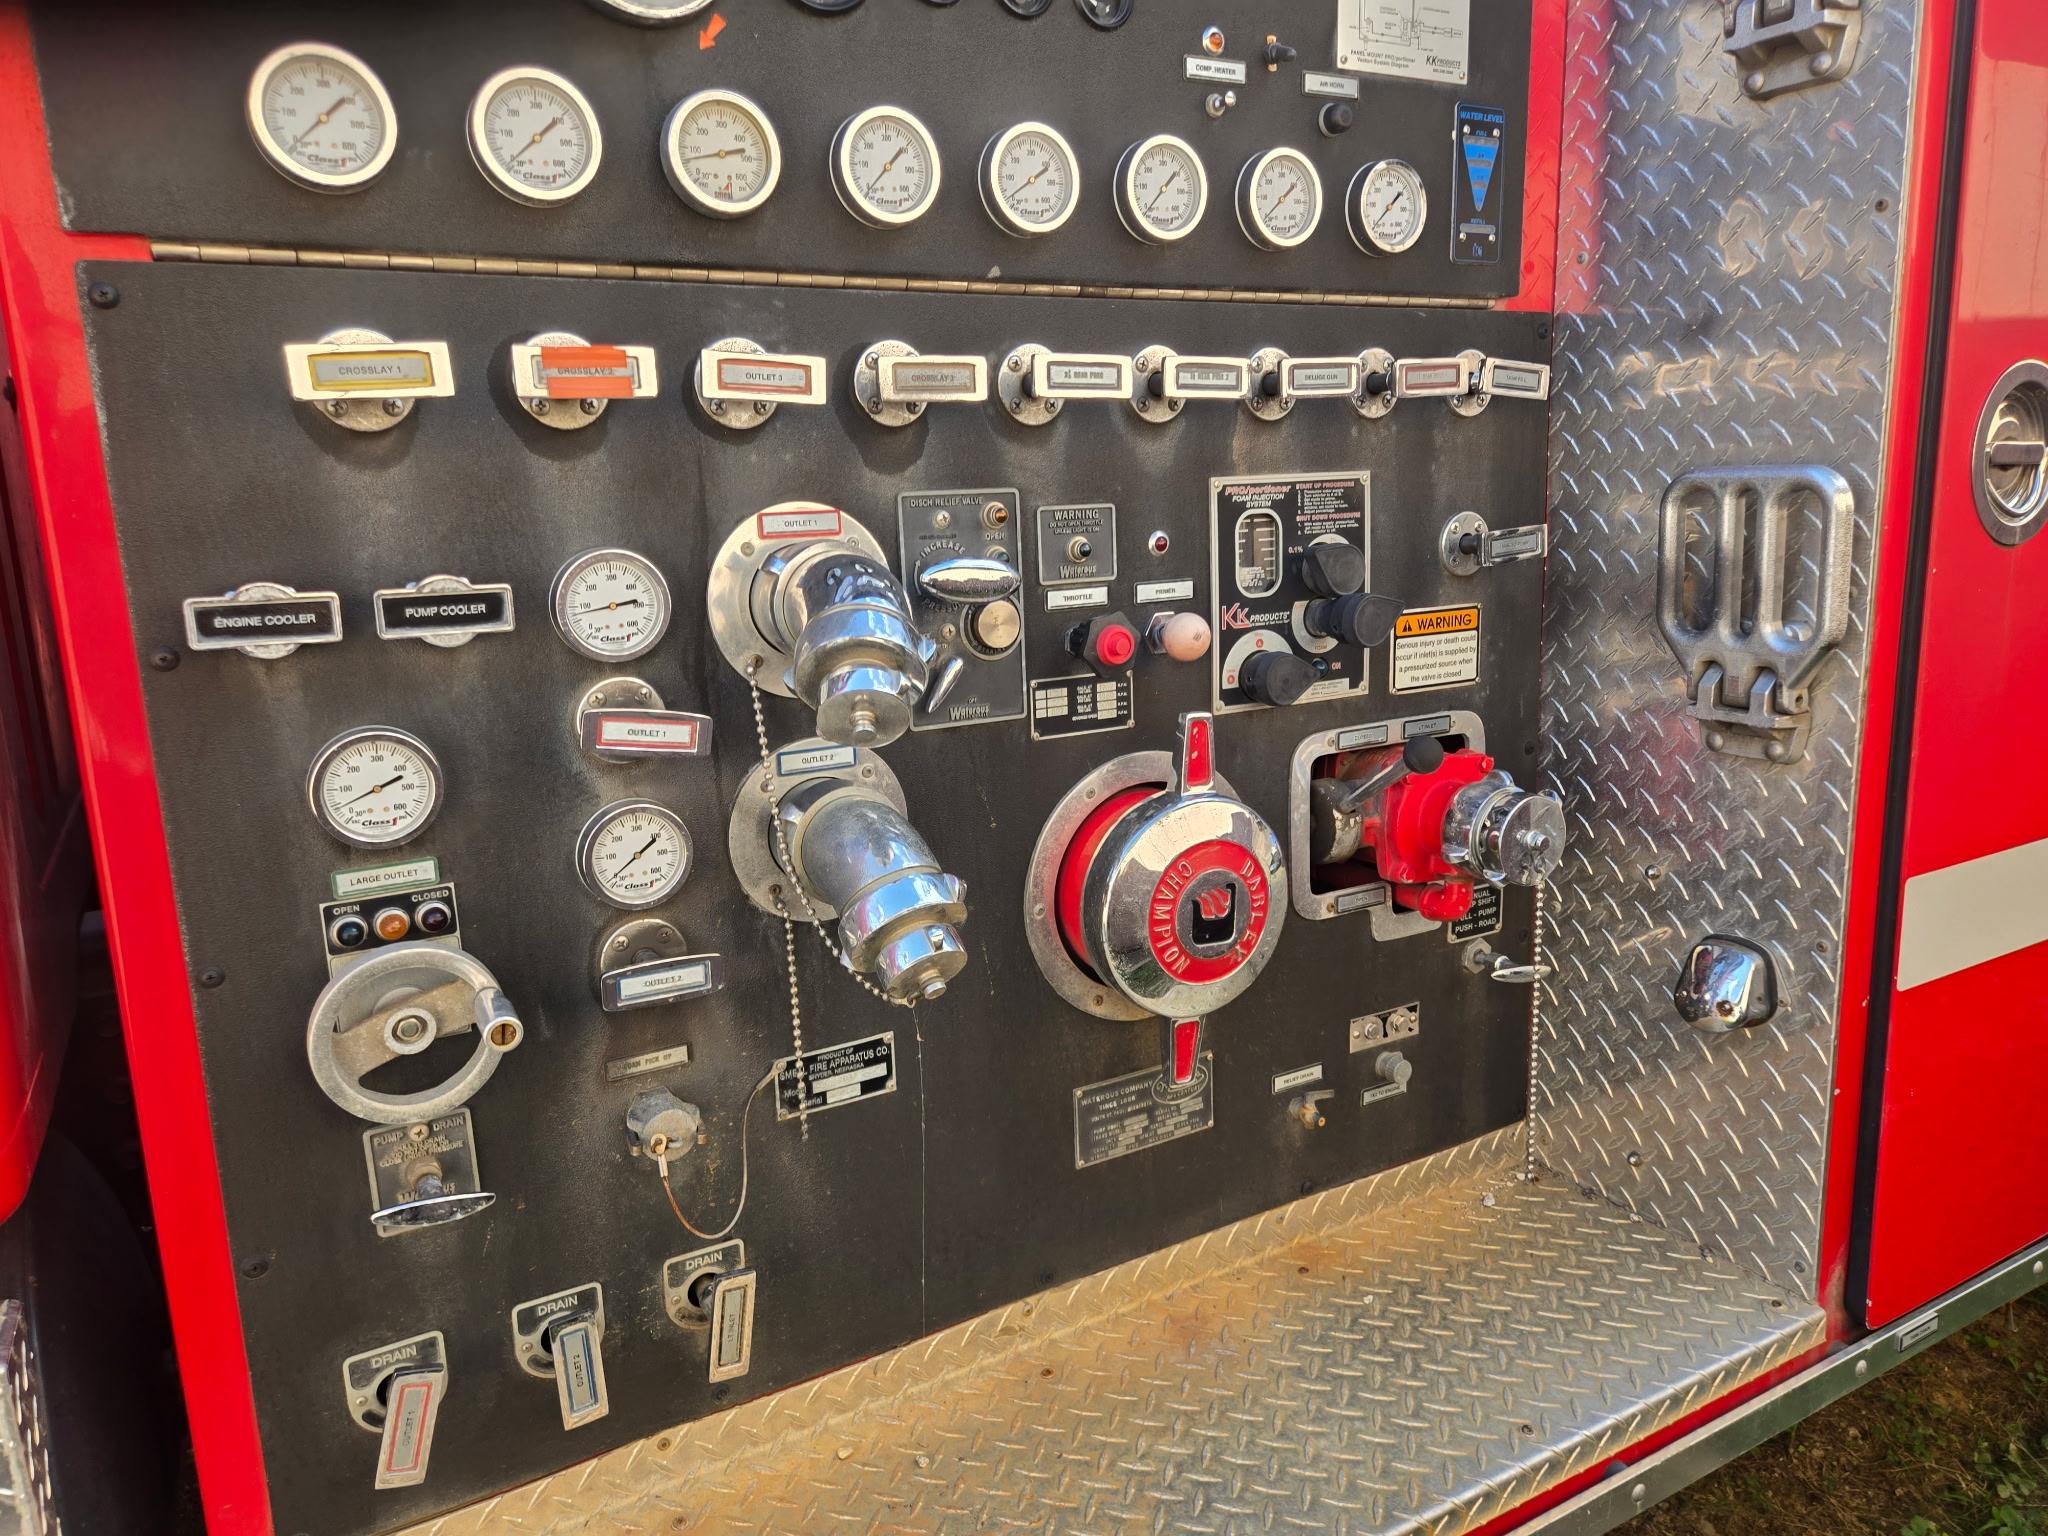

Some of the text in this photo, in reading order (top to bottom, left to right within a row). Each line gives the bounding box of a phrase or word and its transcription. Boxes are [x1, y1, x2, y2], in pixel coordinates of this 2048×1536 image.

[1214, 67, 1236, 75] HEATER
[1329, 81, 1344, 89] HORN
[282, 108, 296, 116] 100
[507, 109, 519, 117] 200
[1460, 111, 1504, 123] WATER LEVEL
[501, 129, 513, 137] 100
[339, 365, 392, 375] CROSSLAY
[746, 372, 776, 381] OUTLET
[910, 497, 983, 507] DISCH RELIEF VALVE
[1246, 500, 1271, 508] SYSTEM
[1055, 509, 1099, 520] WARNING
[920, 542, 966, 558] INCREASE
[406, 604, 486, 618] PUMP COOLER
[214, 614, 315, 629] ENGINE COOLER
[1250, 612, 1288, 622] PRODUCTS
[1418, 614, 1472, 630] WARNING
[1420, 640, 1435, 648] injury
[1396, 653, 1412, 661] occur
[1419, 650, 1437, 658] inlet(s)
[1445, 647, 1468, 656] supplied
[1332, 662, 1341, 670] ON
[1404, 662, 1436, 673] pressurized
[1439, 659, 1457, 667] source
[1411, 674, 1420, 682] the
[1421, 673, 1435, 681] valve
[628, 728, 660, 737] OUTLET
[802, 755, 828, 764] OUTLET
[350, 869, 418, 886] LARGE OUTLET
[412, 890, 449, 902] CLOSED
[1478, 896, 1496, 906] SHIFT
[333, 905, 360, 915] OPEN
[1456, 912, 1472, 922] ULL
[1478, 907, 1496, 916] PUMP
[1153, 859, 1193, 975] CHAMPION
[1455, 923, 1473, 933] PUSH
[1479, 918, 1496, 927] ROAD
[644, 977, 675, 987] OUTLET
[809, 1062, 828, 1073] FIRE
[829, 1050, 874, 1069] APPARATUS
[876, 1046, 889, 1056] CO.
[817, 1050, 845, 1061] PRODUCT
[1082, 1081, 1153, 1106] WATEROUS COMPANY
[374, 1116, 465, 1145] PUMP DRAIN
[686, 1251, 722, 1270] DRAIN
[538, 1295, 578, 1316] DRAIN
[371, 1345, 417, 1369] DRAIN
